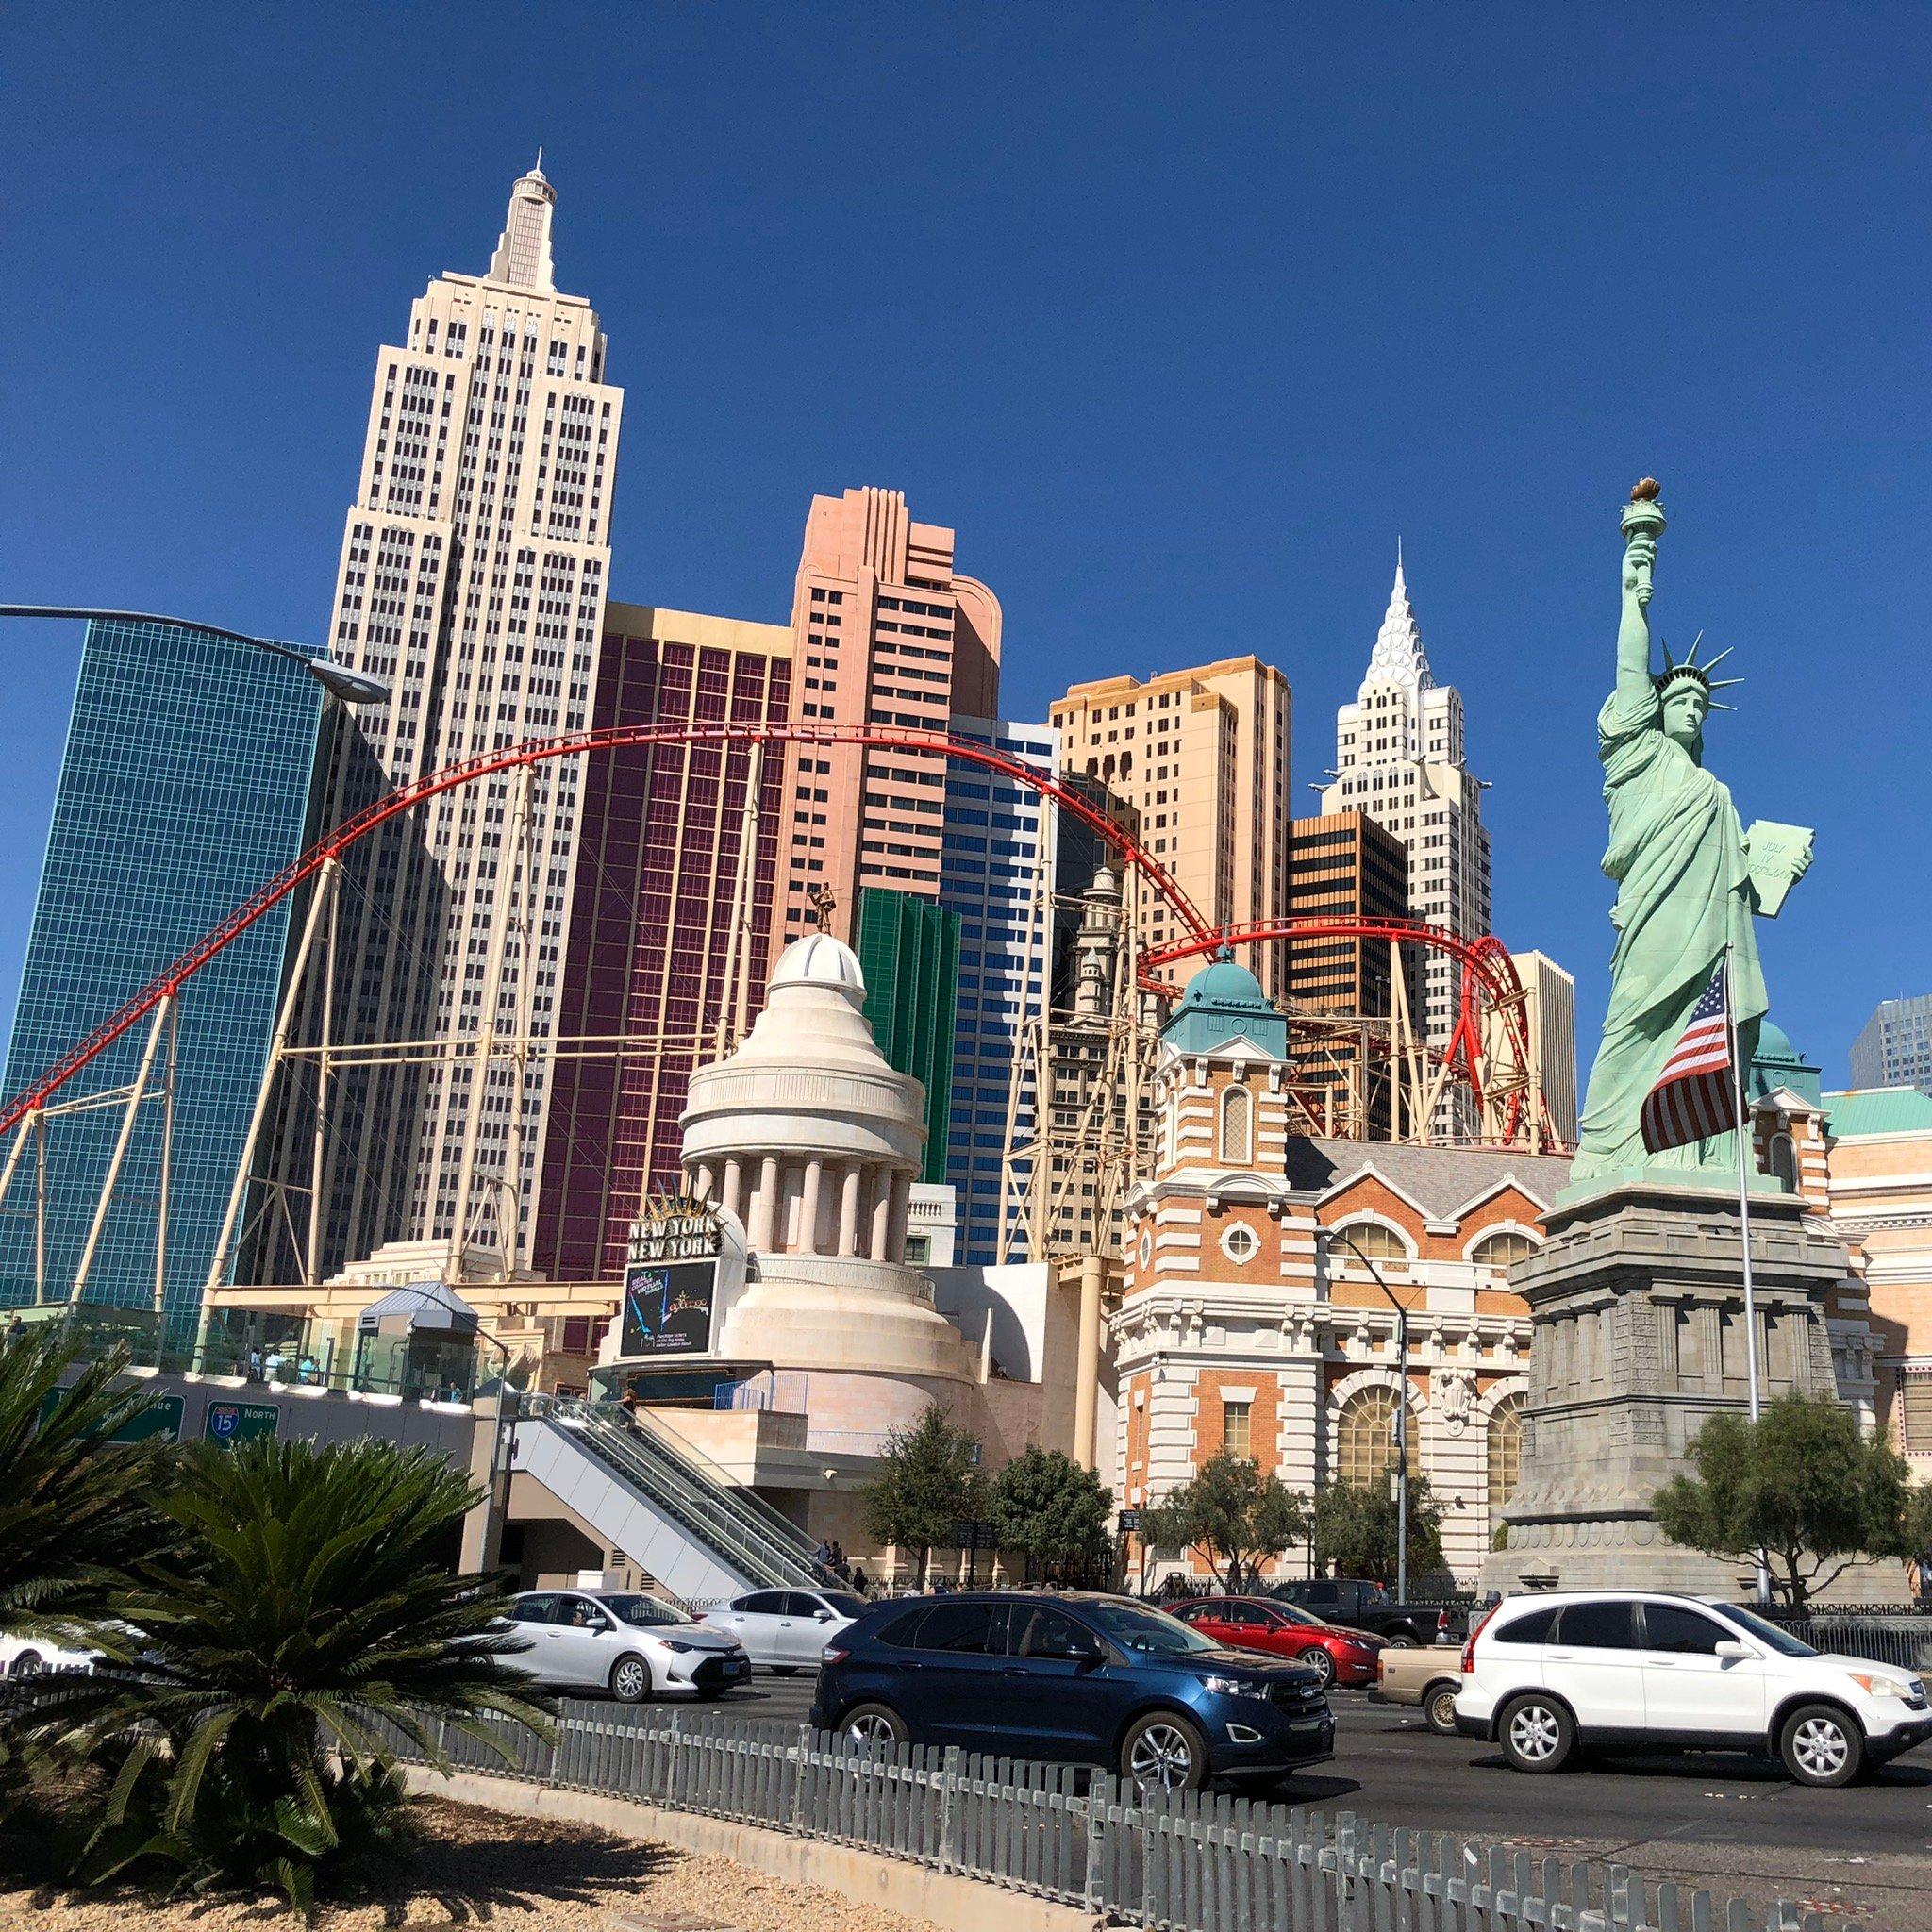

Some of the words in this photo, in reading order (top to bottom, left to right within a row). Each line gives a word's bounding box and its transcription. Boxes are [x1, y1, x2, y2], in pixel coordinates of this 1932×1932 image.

[629, 1221, 667, 1239] NEW
[671, 1216, 718, 1235] YORK
[627, 1241, 665, 1259] NEW
[670, 1237, 716, 1257] YORK
[218, 1415, 233, 1431] 15
[244, 1408, 275, 1420] NORTH
